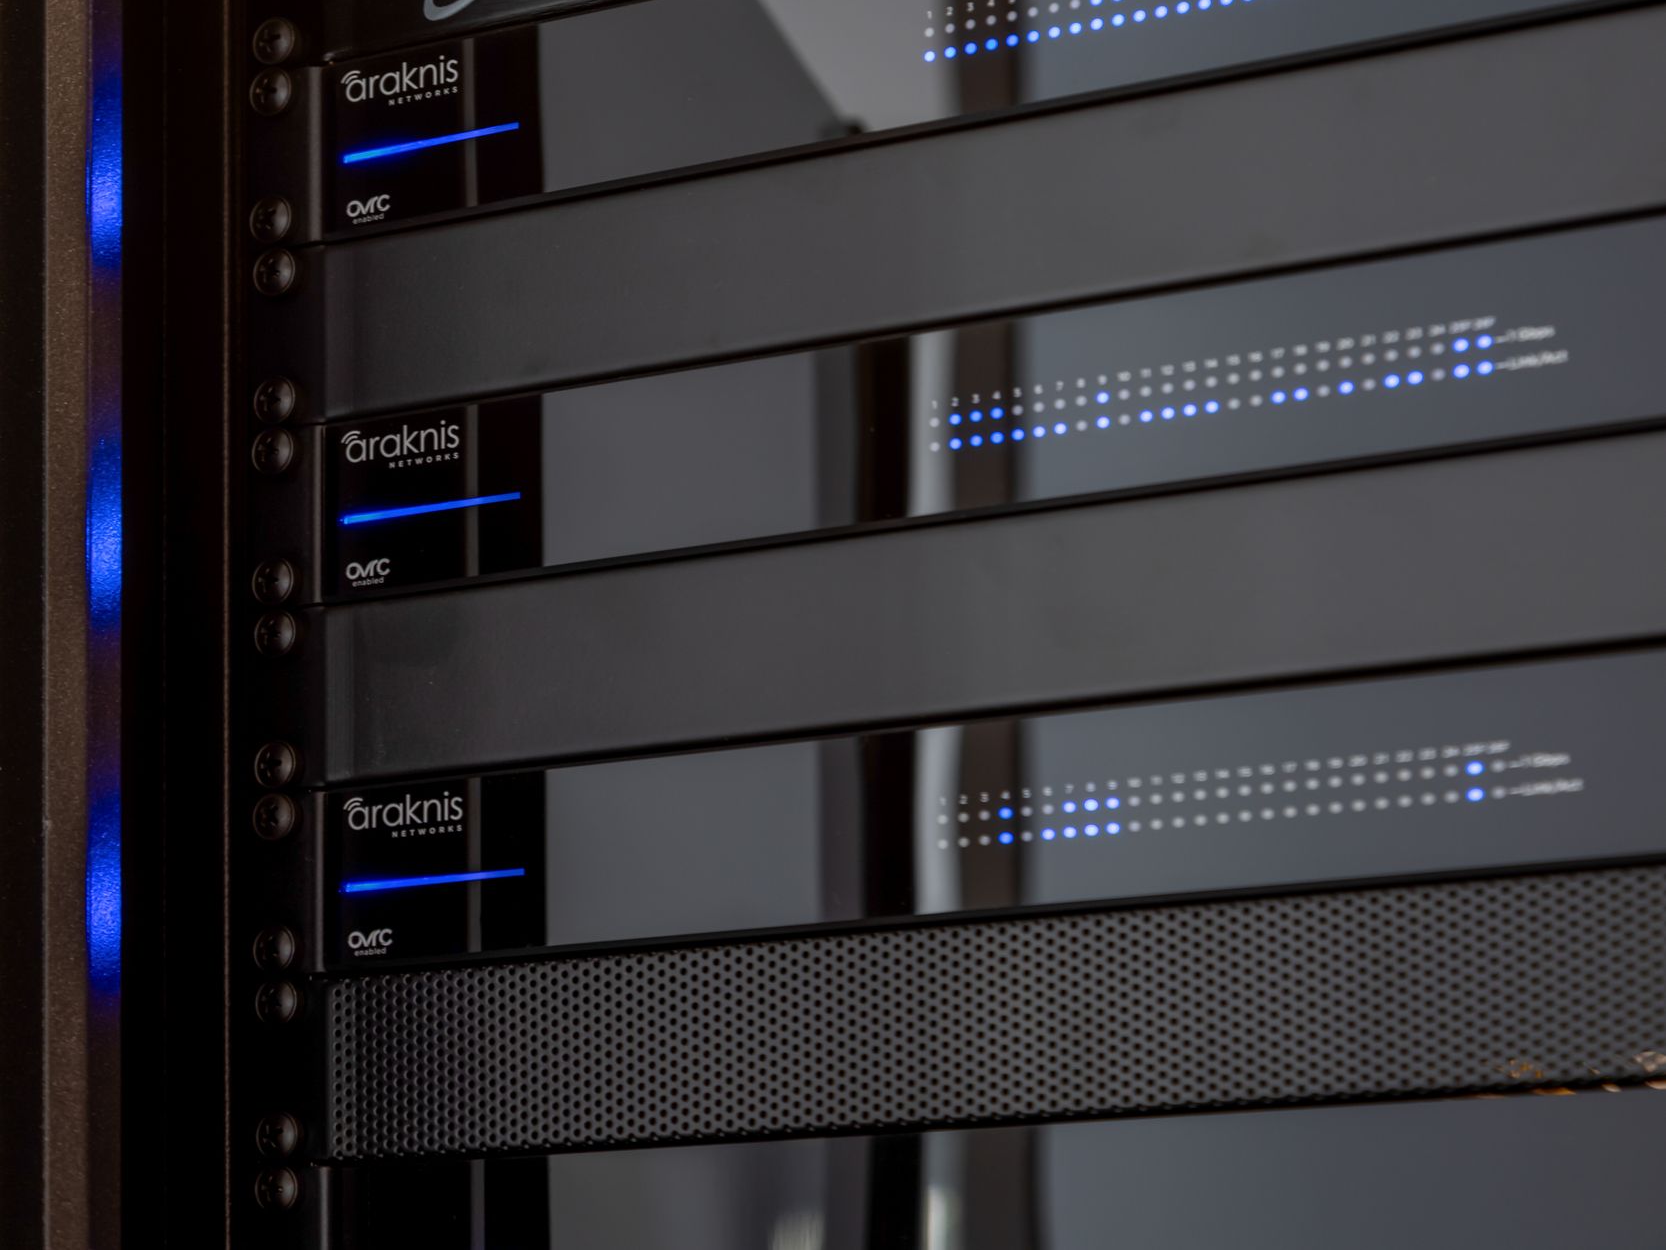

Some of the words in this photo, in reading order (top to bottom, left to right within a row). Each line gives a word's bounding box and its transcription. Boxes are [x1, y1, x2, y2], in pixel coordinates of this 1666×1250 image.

[946, 6, 953, 16] 2
[967, 2, 974, 12] 3
[341, 55, 459, 102] araknis
[388, 86, 458, 106] NETWORKS
[352, 213, 384, 225] enabled
[341, 420, 460, 463] araknis
[389, 452, 459, 469] NETWORKS
[352, 577, 384, 587] enabled
[343, 791, 463, 830] araknis
[392, 824, 463, 838] NETWORKS
[354, 947, 386, 956] enabled
